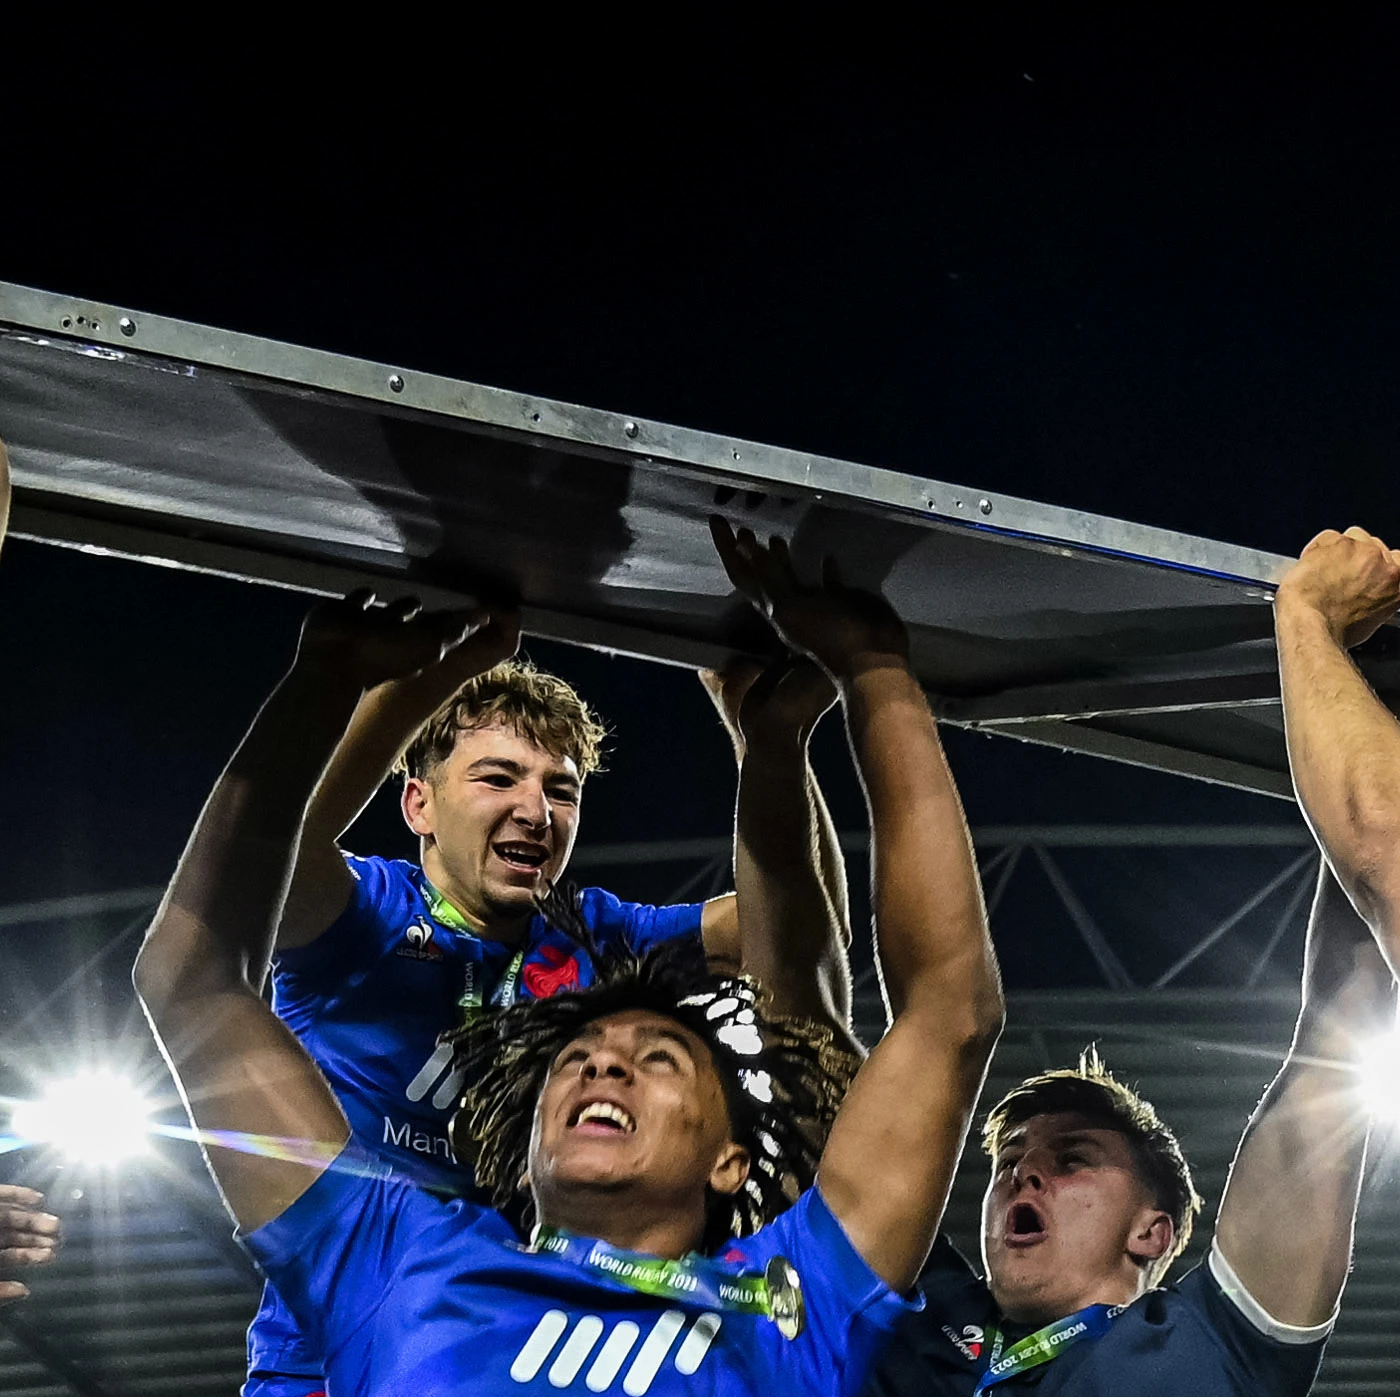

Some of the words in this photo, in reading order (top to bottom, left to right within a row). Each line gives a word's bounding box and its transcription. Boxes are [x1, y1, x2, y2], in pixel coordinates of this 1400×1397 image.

[589, 1248, 634, 1276] WORLD
[1049, 1321, 1088, 1346] WORLD
[990, 1355, 1020, 1376] 2023
